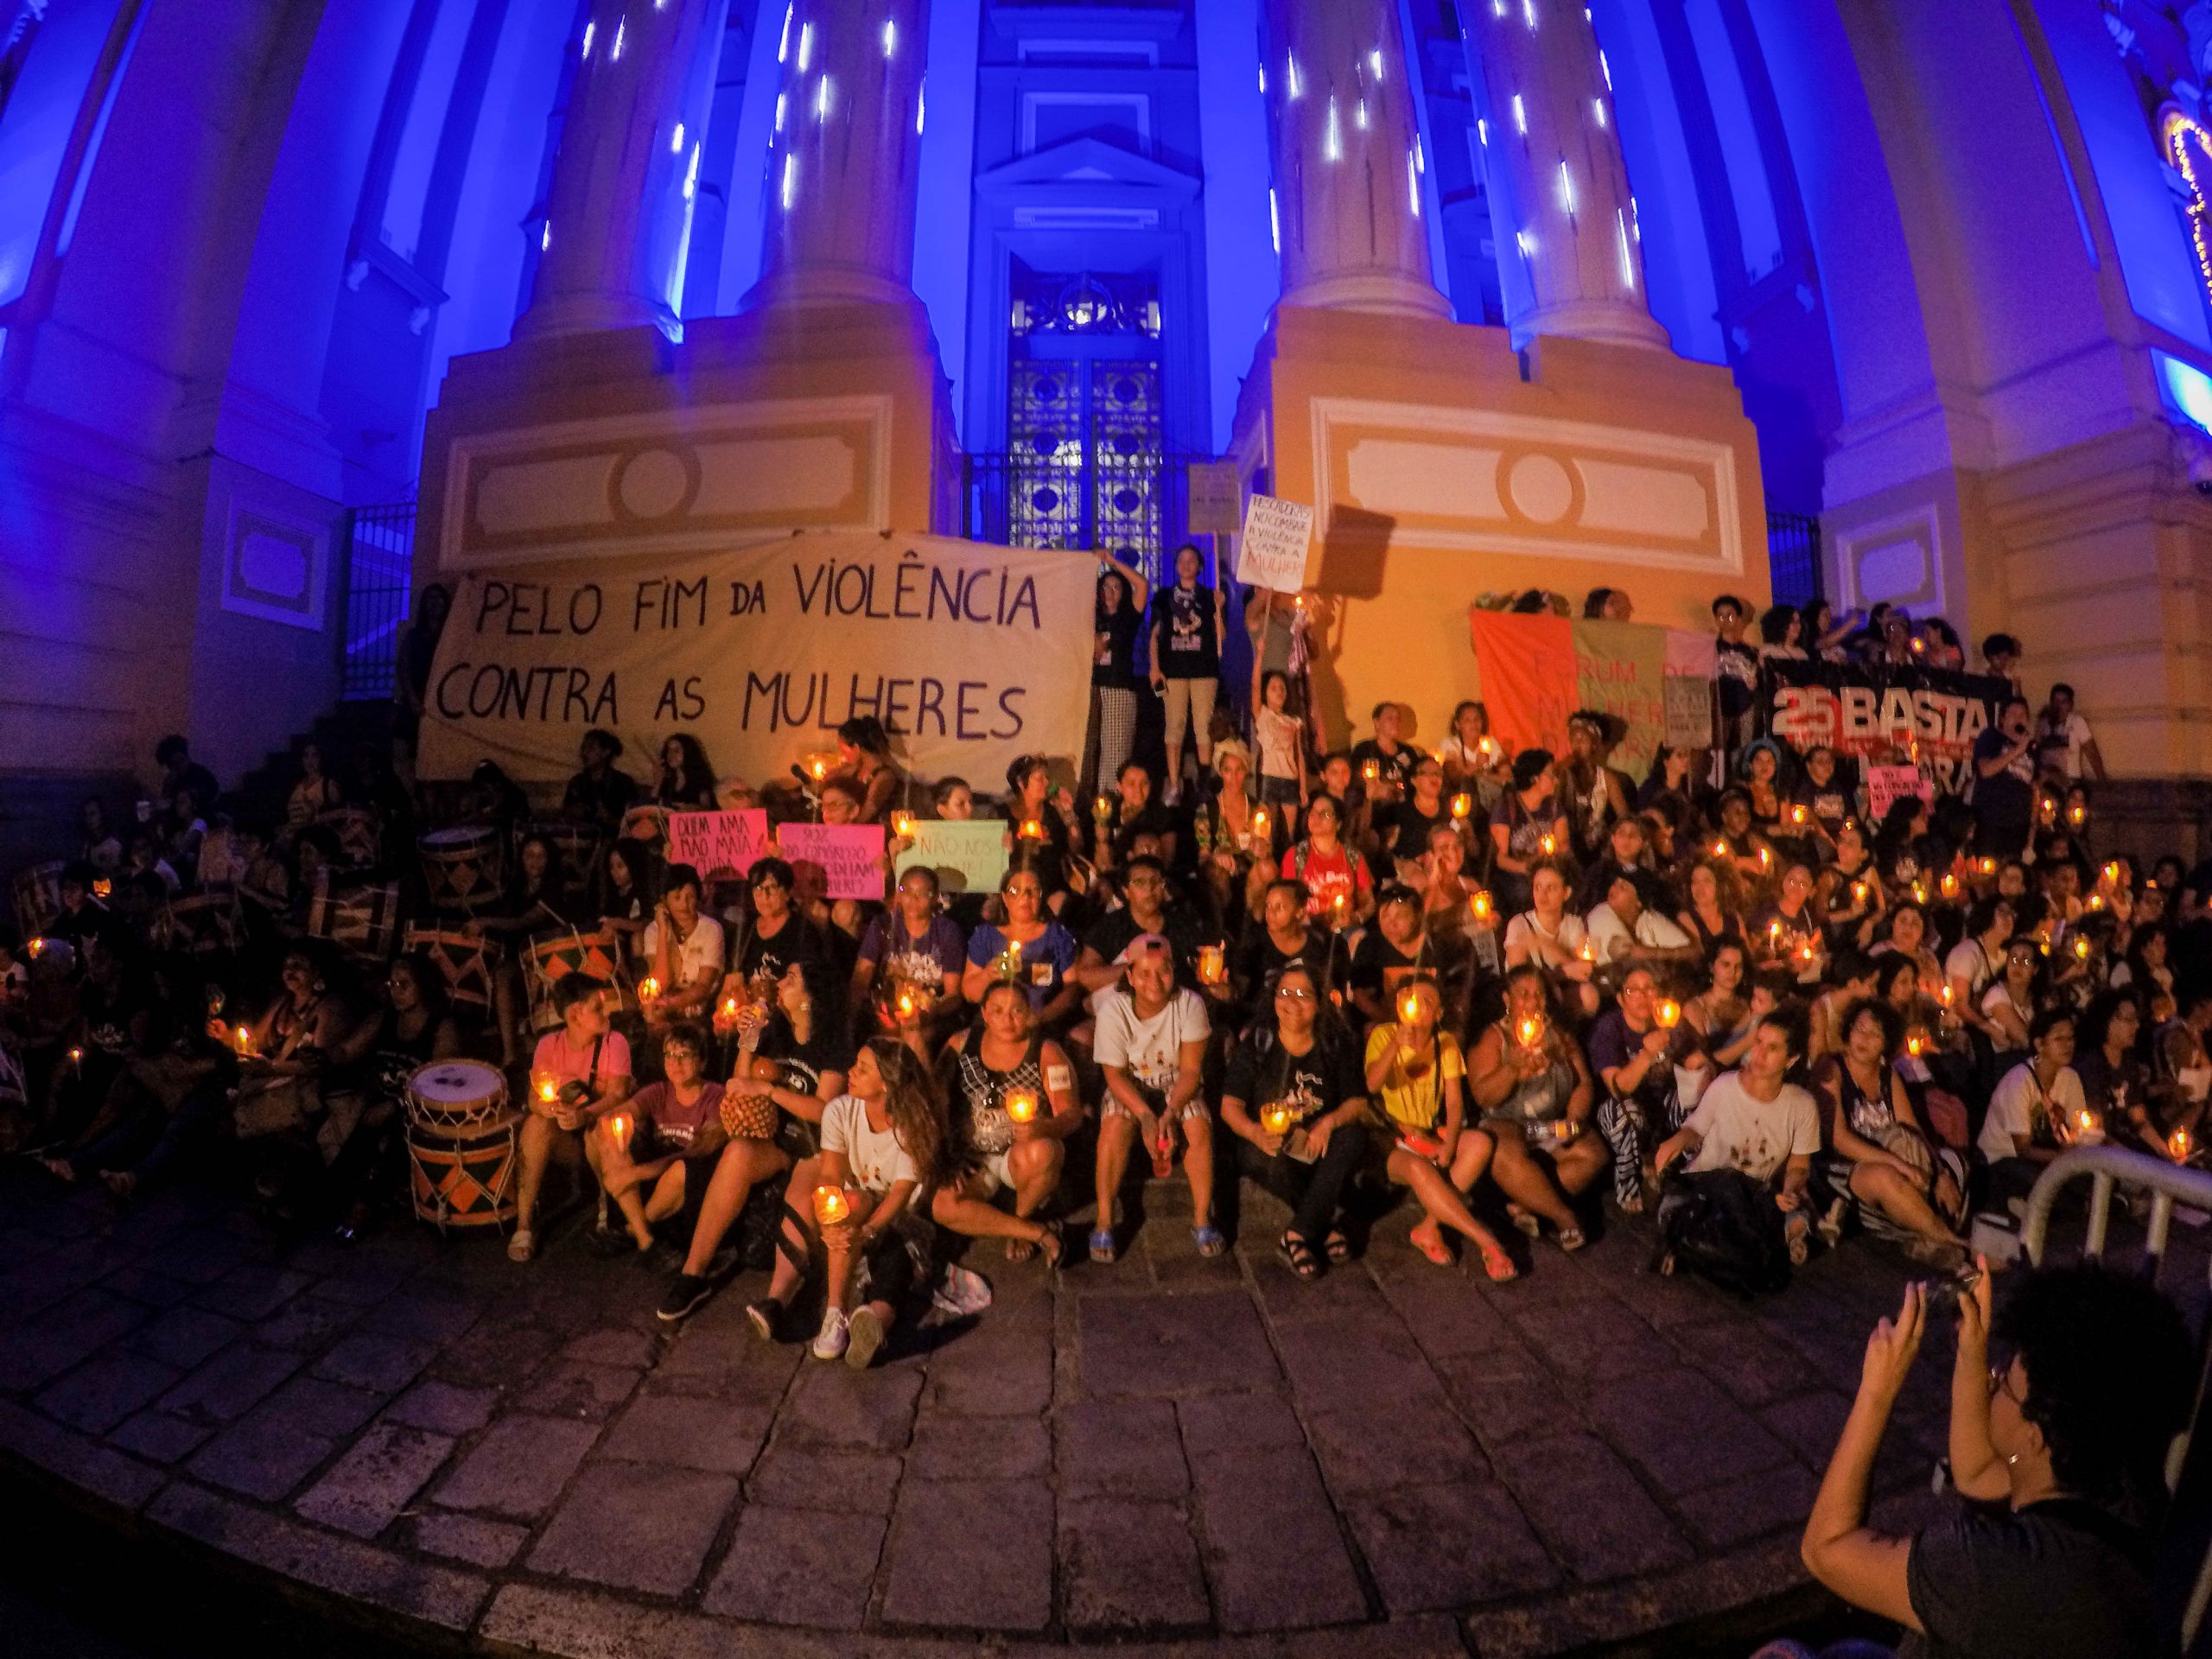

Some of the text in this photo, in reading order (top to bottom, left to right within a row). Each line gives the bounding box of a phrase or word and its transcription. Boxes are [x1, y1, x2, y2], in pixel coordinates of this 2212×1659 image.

[1249, 524, 1255, 535] A
[476, 550, 1042, 637] PELO FIM DA VIOLÊNCIA
[436, 662, 1026, 741] CONTRA AS MULHERES
[1771, 686, 1836, 735] 25
[677, 815, 750, 838] QUEM AMA
